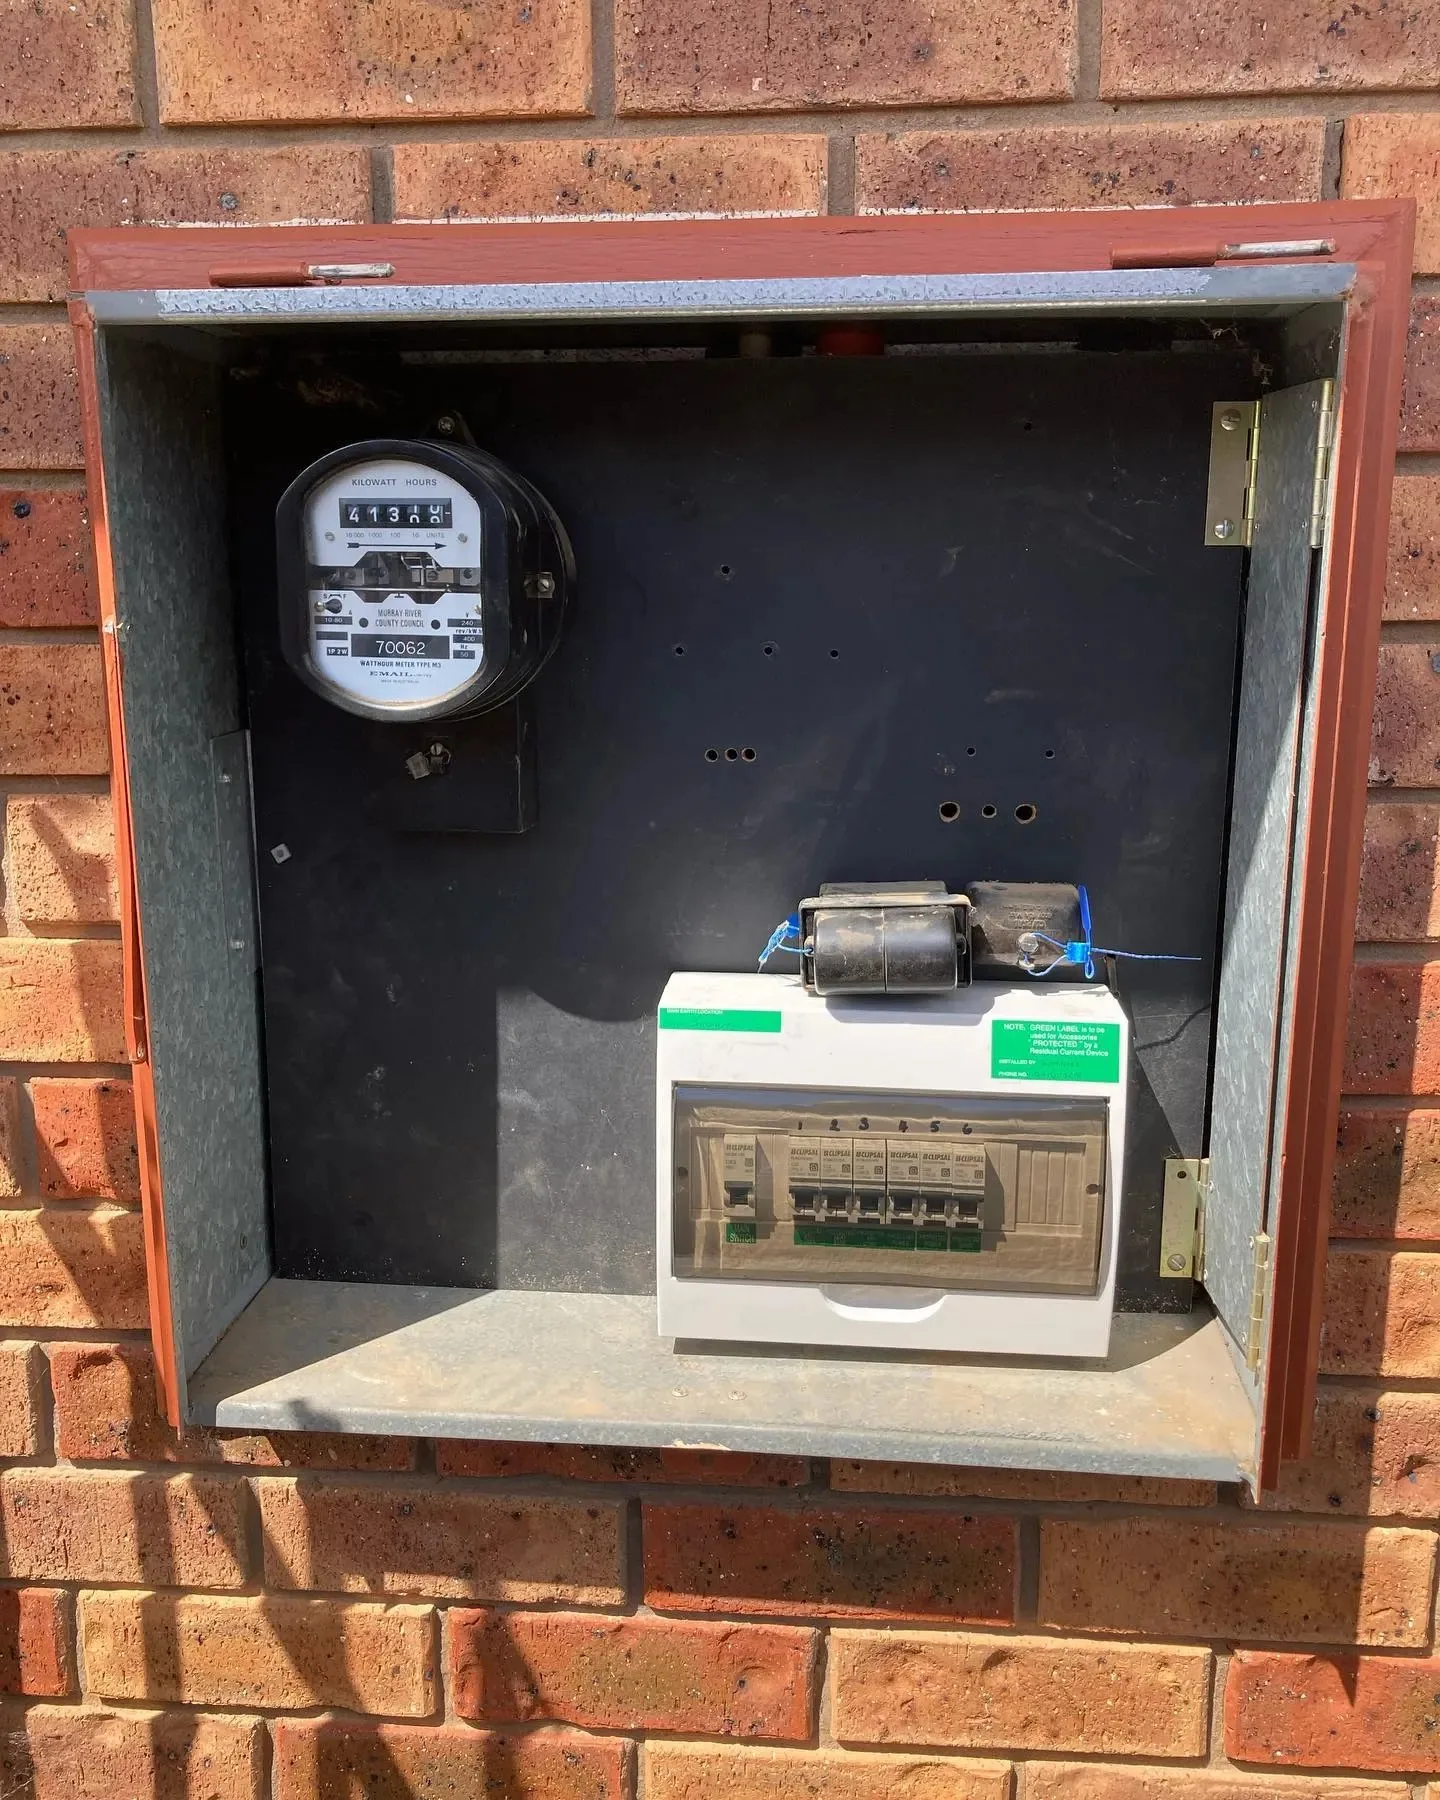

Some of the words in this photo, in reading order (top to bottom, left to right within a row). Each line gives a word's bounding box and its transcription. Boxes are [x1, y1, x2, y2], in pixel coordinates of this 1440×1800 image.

[351, 478, 397, 487] KILOWATT
[405, 478, 437, 487] HOURS
[377, 609, 403, 618] MURRAY
[404, 609, 422, 618] RIVER
[375, 619, 399, 628] COUNTY
[401, 619, 425, 628] COUNCIL
[375, 640, 426, 655] 70062
[360, 660, 393, 668] WATTHOUR
[416, 661, 431, 669] TYPE
[1030, 1024, 1056, 1032] GREEN
[1057, 1025, 1080, 1033] LABEL
[1096, 1026, 1105, 1034] be
[1084, 1042, 1092, 1050] by
[1029, 1047, 1059, 1055] Residual
[1059, 1048, 1085, 1056] Current
[1085, 1049, 1109, 1057] Device
[797, 1120, 803, 1131] 1
[829, 1118, 841, 1132] 2
[858, 1117, 870, 1131] 3
[898, 1119, 909, 1133] 4
[930, 1120, 941, 1133] 5
[962, 1122, 973, 1135] 6
[795, 1148, 819, 1157] CLIPSAL
[828, 1149, 851, 1158] CLIPSAL
[860, 1151, 884, 1159] CLIPSAL
[895, 1151, 919, 1160] CLIPSAL
[927, 1153, 951, 1161] CLIPSAL
